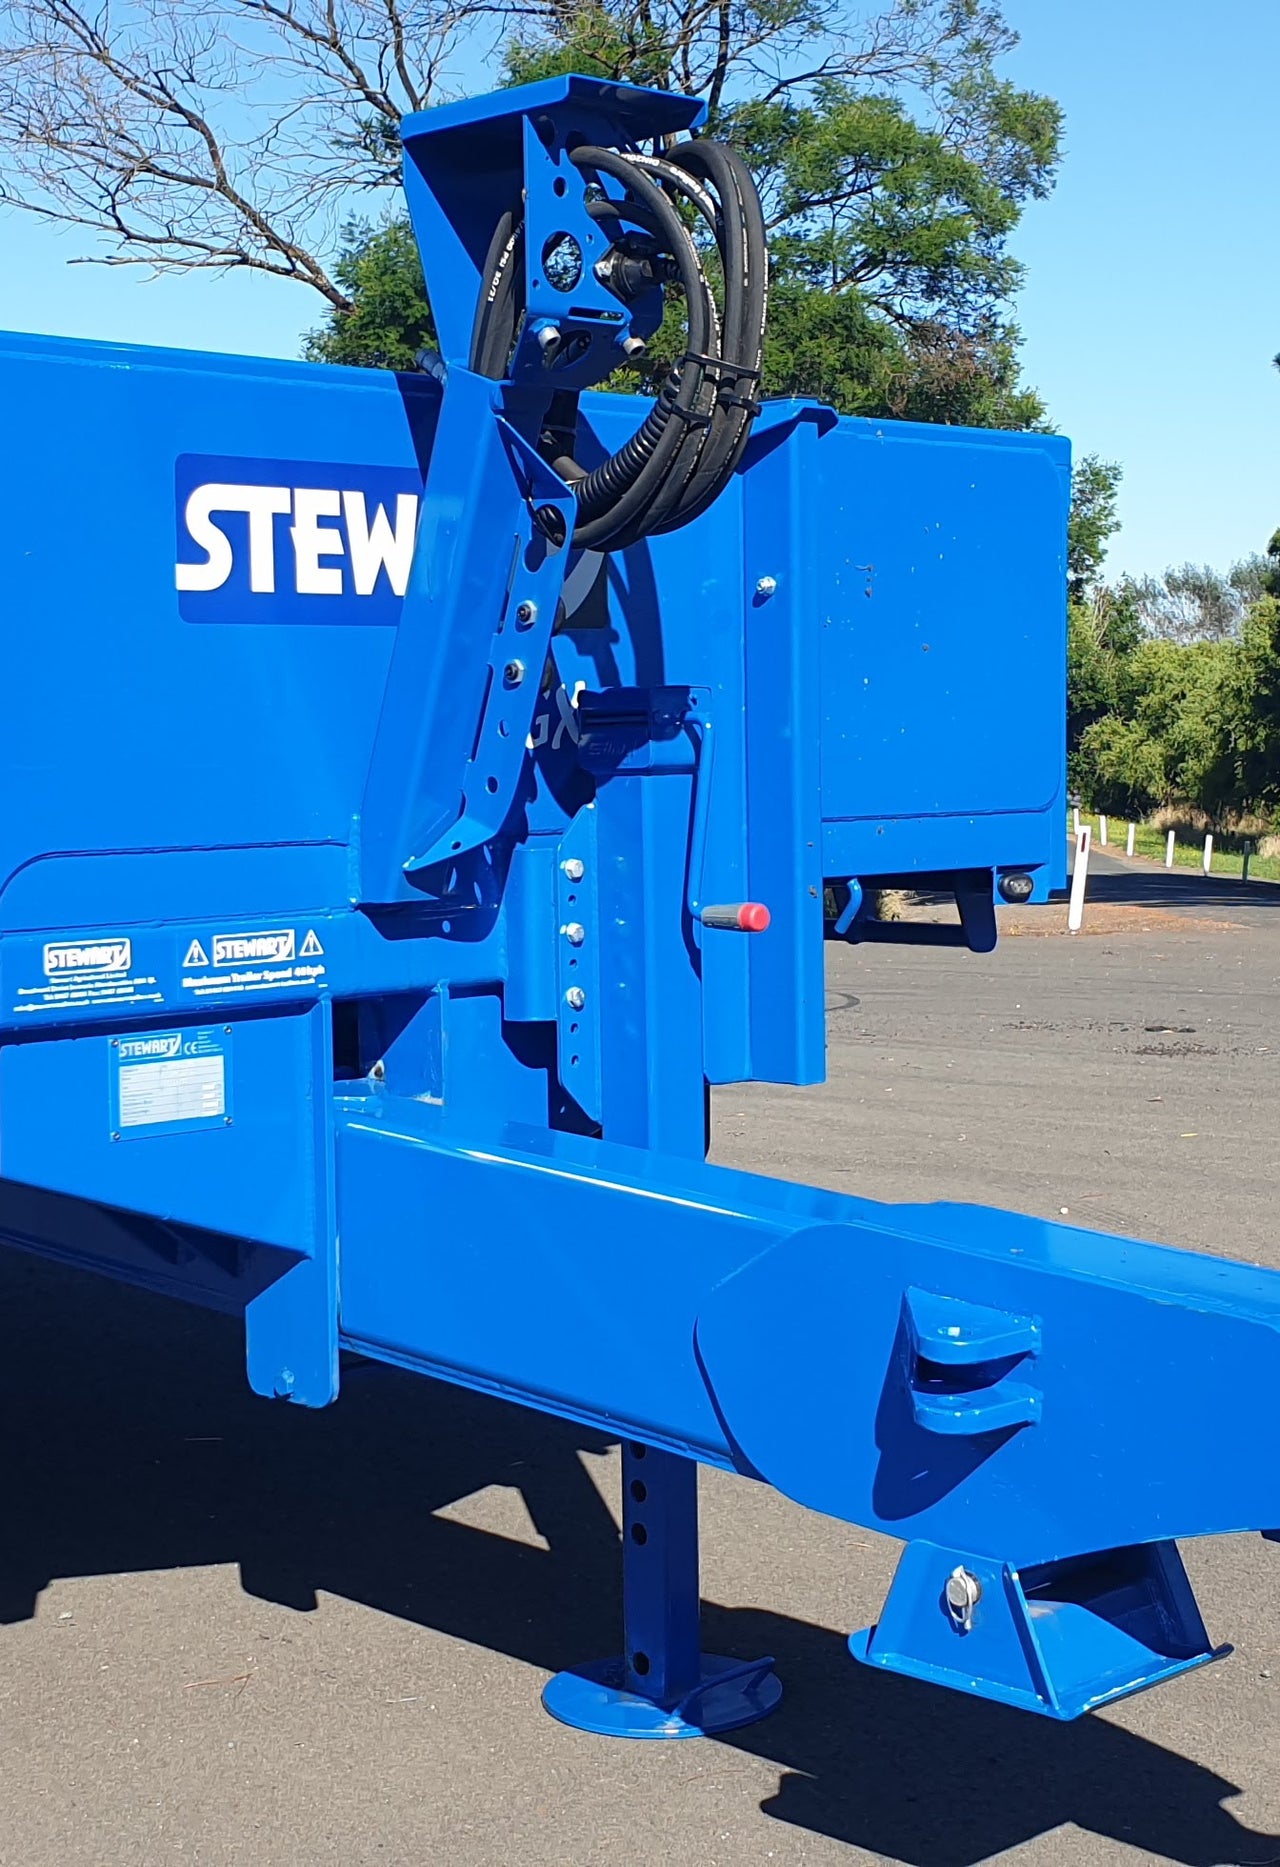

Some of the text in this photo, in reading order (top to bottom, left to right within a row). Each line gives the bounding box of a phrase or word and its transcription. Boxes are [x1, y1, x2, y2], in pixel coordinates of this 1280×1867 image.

[175, 483, 418, 597] STEW
[48, 944, 124, 969] STEWART
[216, 936, 288, 960] STEWART
[119, 1037, 176, 1058] STEWART
